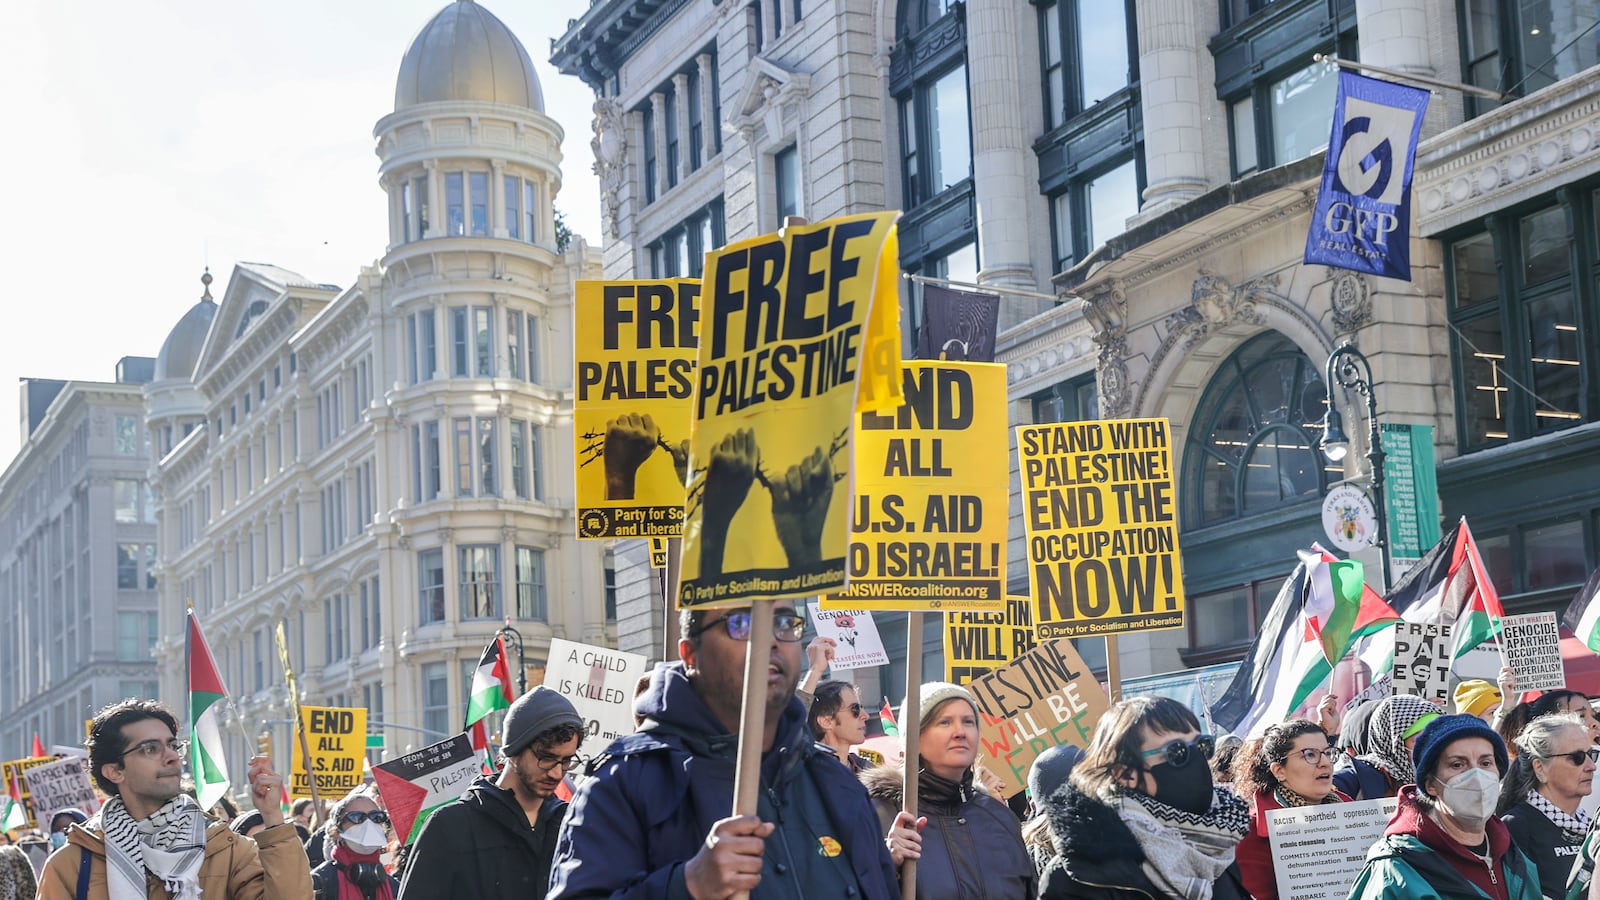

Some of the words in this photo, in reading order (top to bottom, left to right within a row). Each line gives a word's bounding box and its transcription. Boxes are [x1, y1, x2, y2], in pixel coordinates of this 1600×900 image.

[1325, 202, 1399, 246] GFP
[1319, 239, 1346, 251] REAL
[711, 219, 878, 360] FREE
[579, 359, 697, 401] PALES
[698, 324, 861, 420] PALESTINE
[1023, 424, 1103, 456] STAND
[1108, 422, 1166, 449] WITH
[884, 438, 952, 477] ALL
[1026, 451, 1168, 488] PALESTINE!
[852, 494, 915, 533] U.S.
[922, 494, 982, 533] AID
[1029, 486, 1104, 530] END
[1111, 482, 1172, 524] THE
[615, 509, 646, 523] Party
[649, 508, 666, 520] for
[615, 524, 637, 535] and
[1032, 526, 1174, 563] OCCUPATION
[877, 542, 1000, 577] ISRAEL!
[696, 586, 715, 600] Party
[715, 583, 728, 596] for
[729, 578, 780, 593] Socialism
[781, 576, 800, 589] and
[801, 569, 844, 587] Liberation
[1035, 554, 1176, 621] NOW!
[817, 609, 866, 621] GENOCIDE
[1502, 619, 1518, 627] CALL
[1526, 616, 1541, 624] WHAT
[1053, 625, 1073, 636] Party
[1076, 625, 1088, 633] for
[1090, 622, 1128, 632] Socialism
[1129, 620, 1144, 629] and
[1145, 617, 1182, 627] Liberation
[1504, 622, 1557, 639] GENOCIDE
[950, 627, 1007, 660] WILL
[1395, 641, 1449, 660] PAL
[1507, 634, 1558, 649] APARTHEID
[568, 649, 578, 664] A
[583, 652, 627, 673] CHILD
[1508, 645, 1559, 659] OCCUPATION
[1509, 655, 1560, 668] COLONIZATION
[1514, 663, 1560, 676] MPERIALISM
[1393, 664, 1449, 682] EST
[1531, 672, 1562, 682] SUPREMACY
[559, 679, 571, 695] IS
[575, 682, 625, 705] KILLED
[1535, 680, 1564, 689] CLEANSING
[310, 710, 353, 734] END
[981, 712, 1048, 758] WILL
[1046, 682, 1088, 724] BE
[318, 737, 344, 751] ALL
[332, 758, 355, 772] AID
[402, 752, 424, 765] FROM
[414, 761, 424, 771] TO
[27, 772, 41, 786] NO
[35, 775, 84, 798] JUSTICE
[430, 763, 477, 793] PALESTINE
[1273, 816, 1296, 826] RACIST
[1304, 811, 1337, 824] apartheid
[1343, 807, 1379, 819] oppression
[1276, 829, 1301, 837] fanatical
[1304, 825, 1339, 834] psychopathic
[1345, 821, 1370, 830] sadistic
[1280, 841, 1298, 849] ethnic
[1298, 838, 1325, 848] cleansing
[1330, 835, 1356, 843] fascism
[1280, 853, 1310, 861] COMMITS
[1311, 848, 1348, 858] ATROCITIES
[1287, 857, 1341, 869] dehumanization
[1289, 872, 1313, 880] torture
